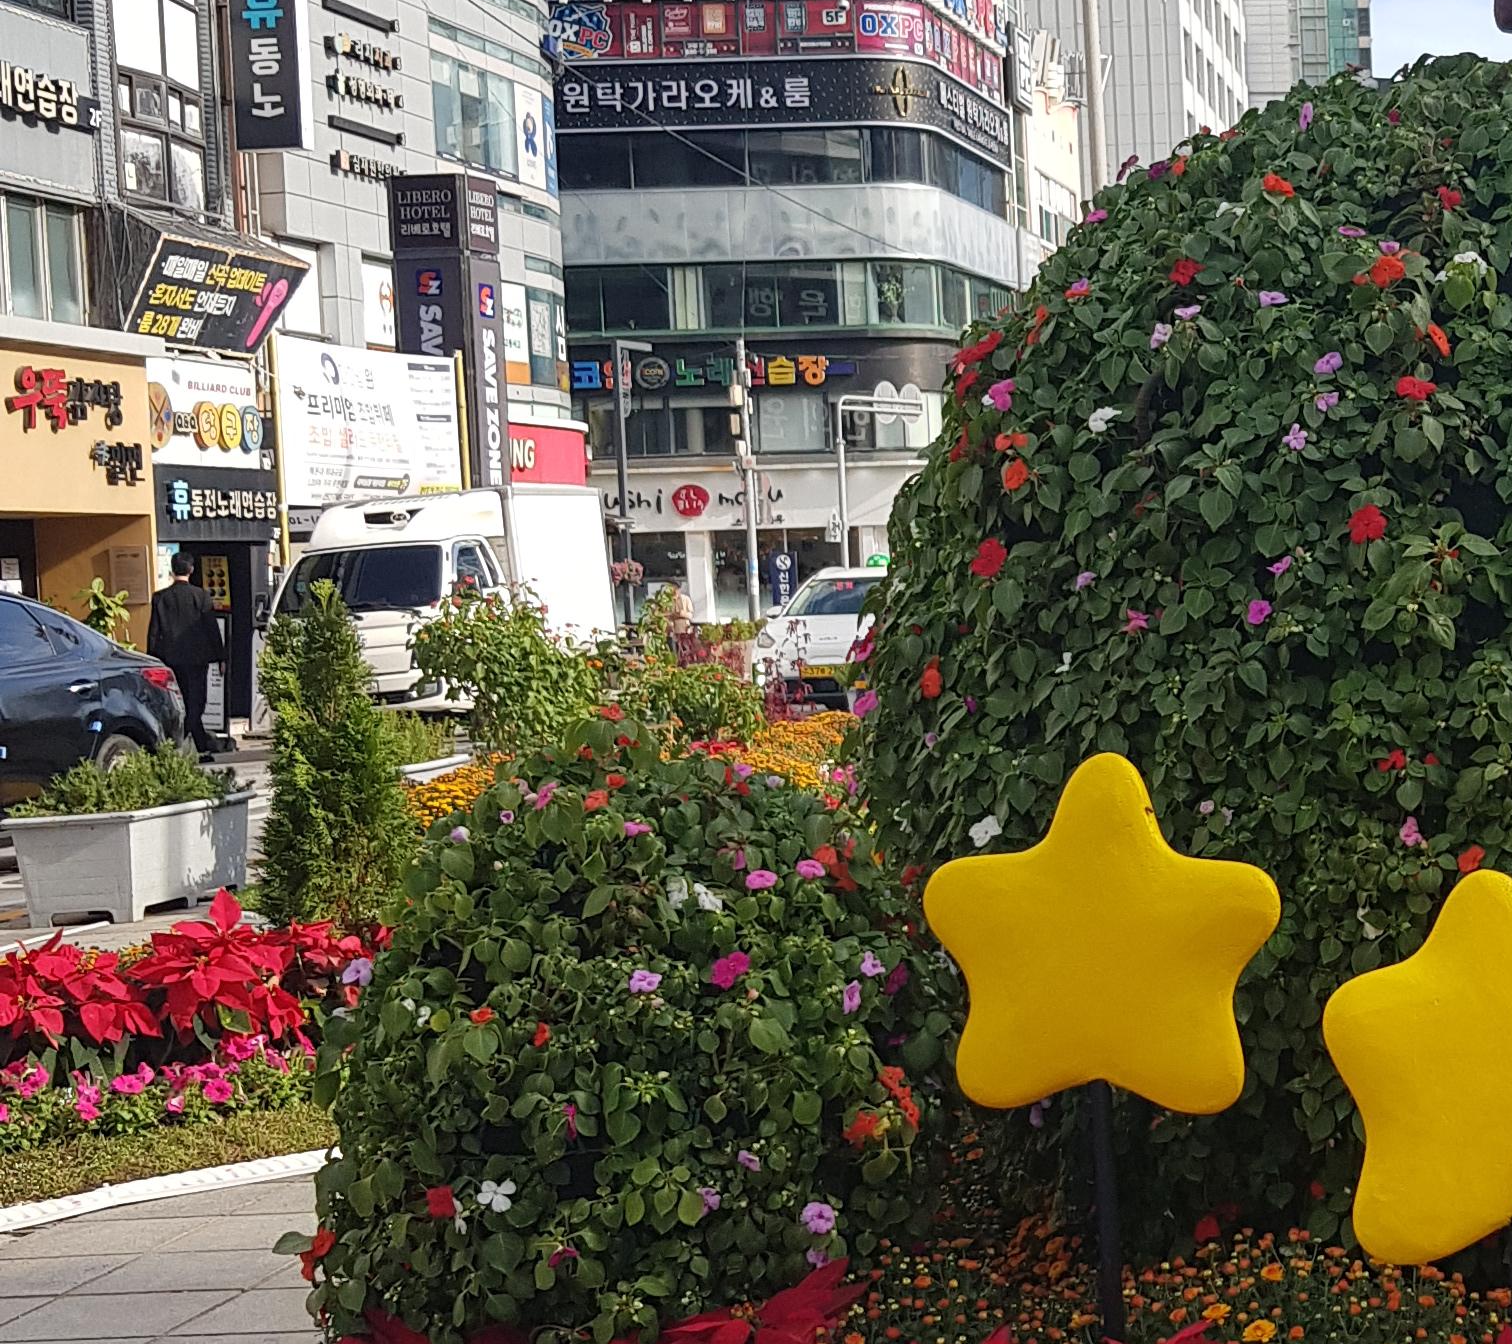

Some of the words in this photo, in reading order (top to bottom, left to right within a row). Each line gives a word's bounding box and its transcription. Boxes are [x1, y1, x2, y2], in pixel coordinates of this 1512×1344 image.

[859, 12, 924, 41] OXPC
[398, 190, 452, 204] LIBERO
[468, 190, 494, 206] LIBERO
[400, 205, 450, 219] HOTEL
[470, 206, 494, 223] HOTEL
[482, 328, 499, 404] SAVE
[187, 380, 227, 393] BILLIARD
[229, 384, 251, 396] CLUB
